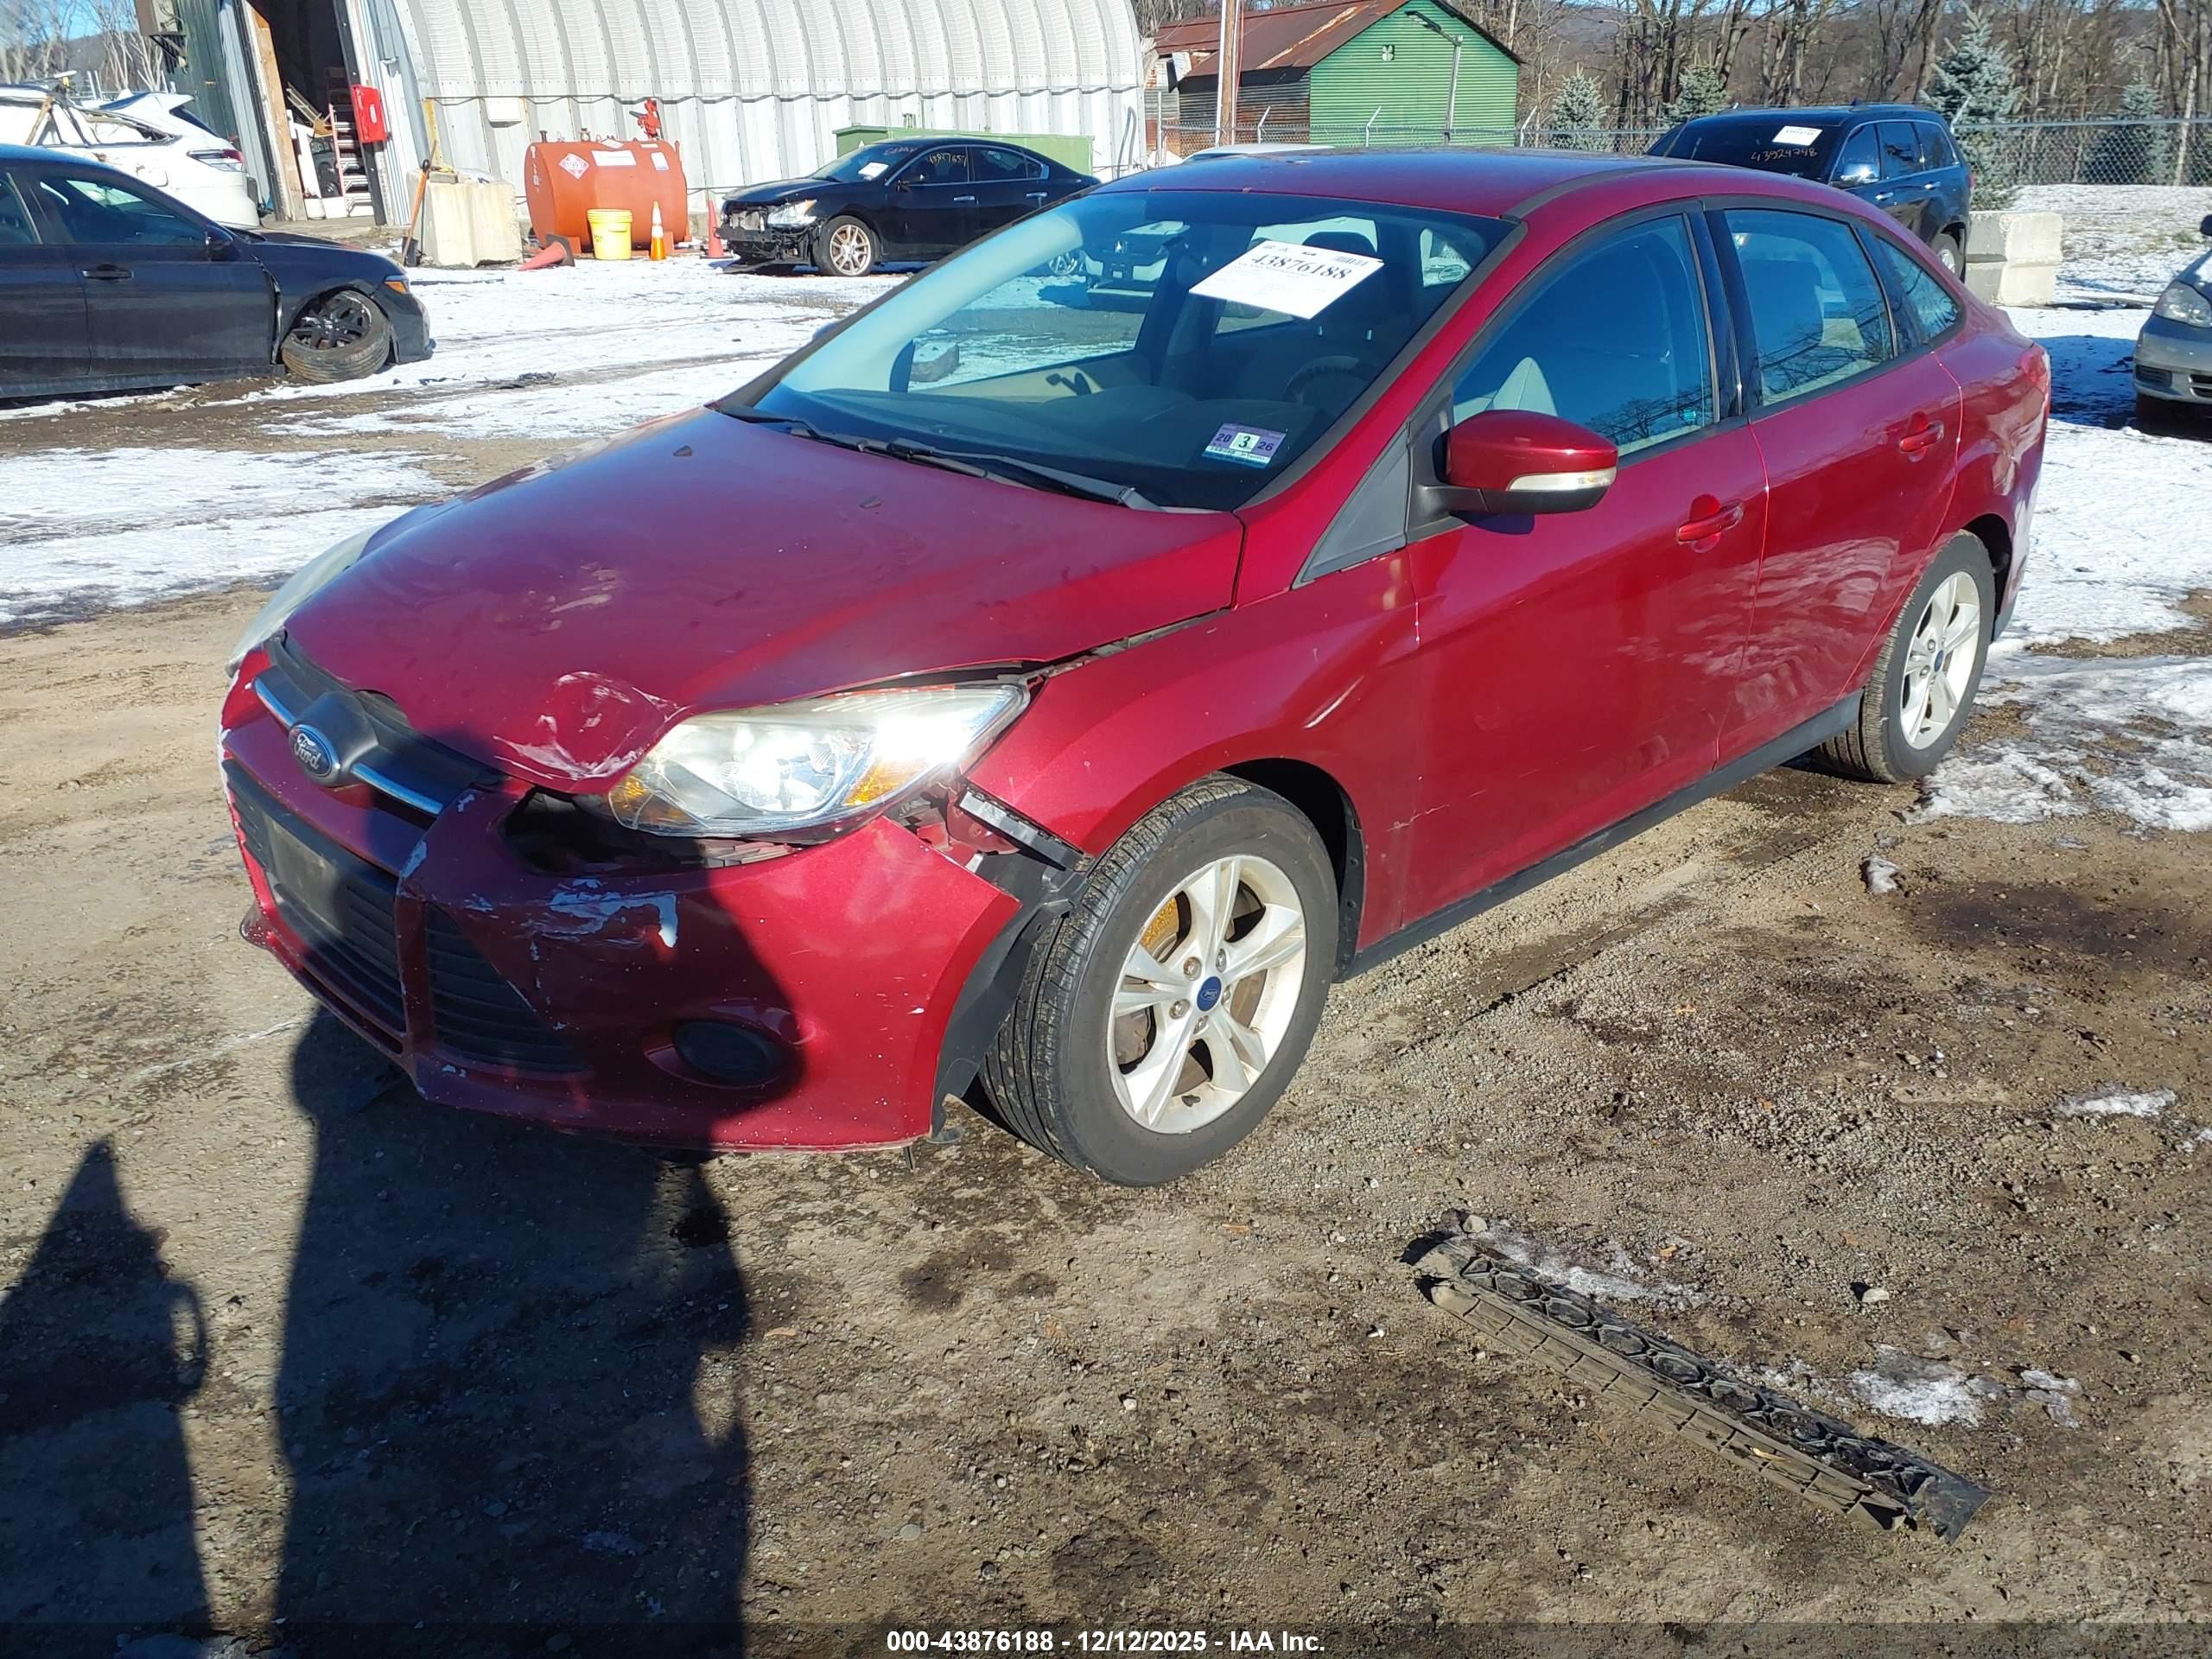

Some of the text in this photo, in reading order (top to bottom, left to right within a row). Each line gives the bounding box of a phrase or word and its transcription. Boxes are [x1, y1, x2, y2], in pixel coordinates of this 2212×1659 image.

[1251, 253, 1352, 280] 43876188
[1215, 432, 1274, 452] 20 3 26
[294, 733, 321, 769] Ford
